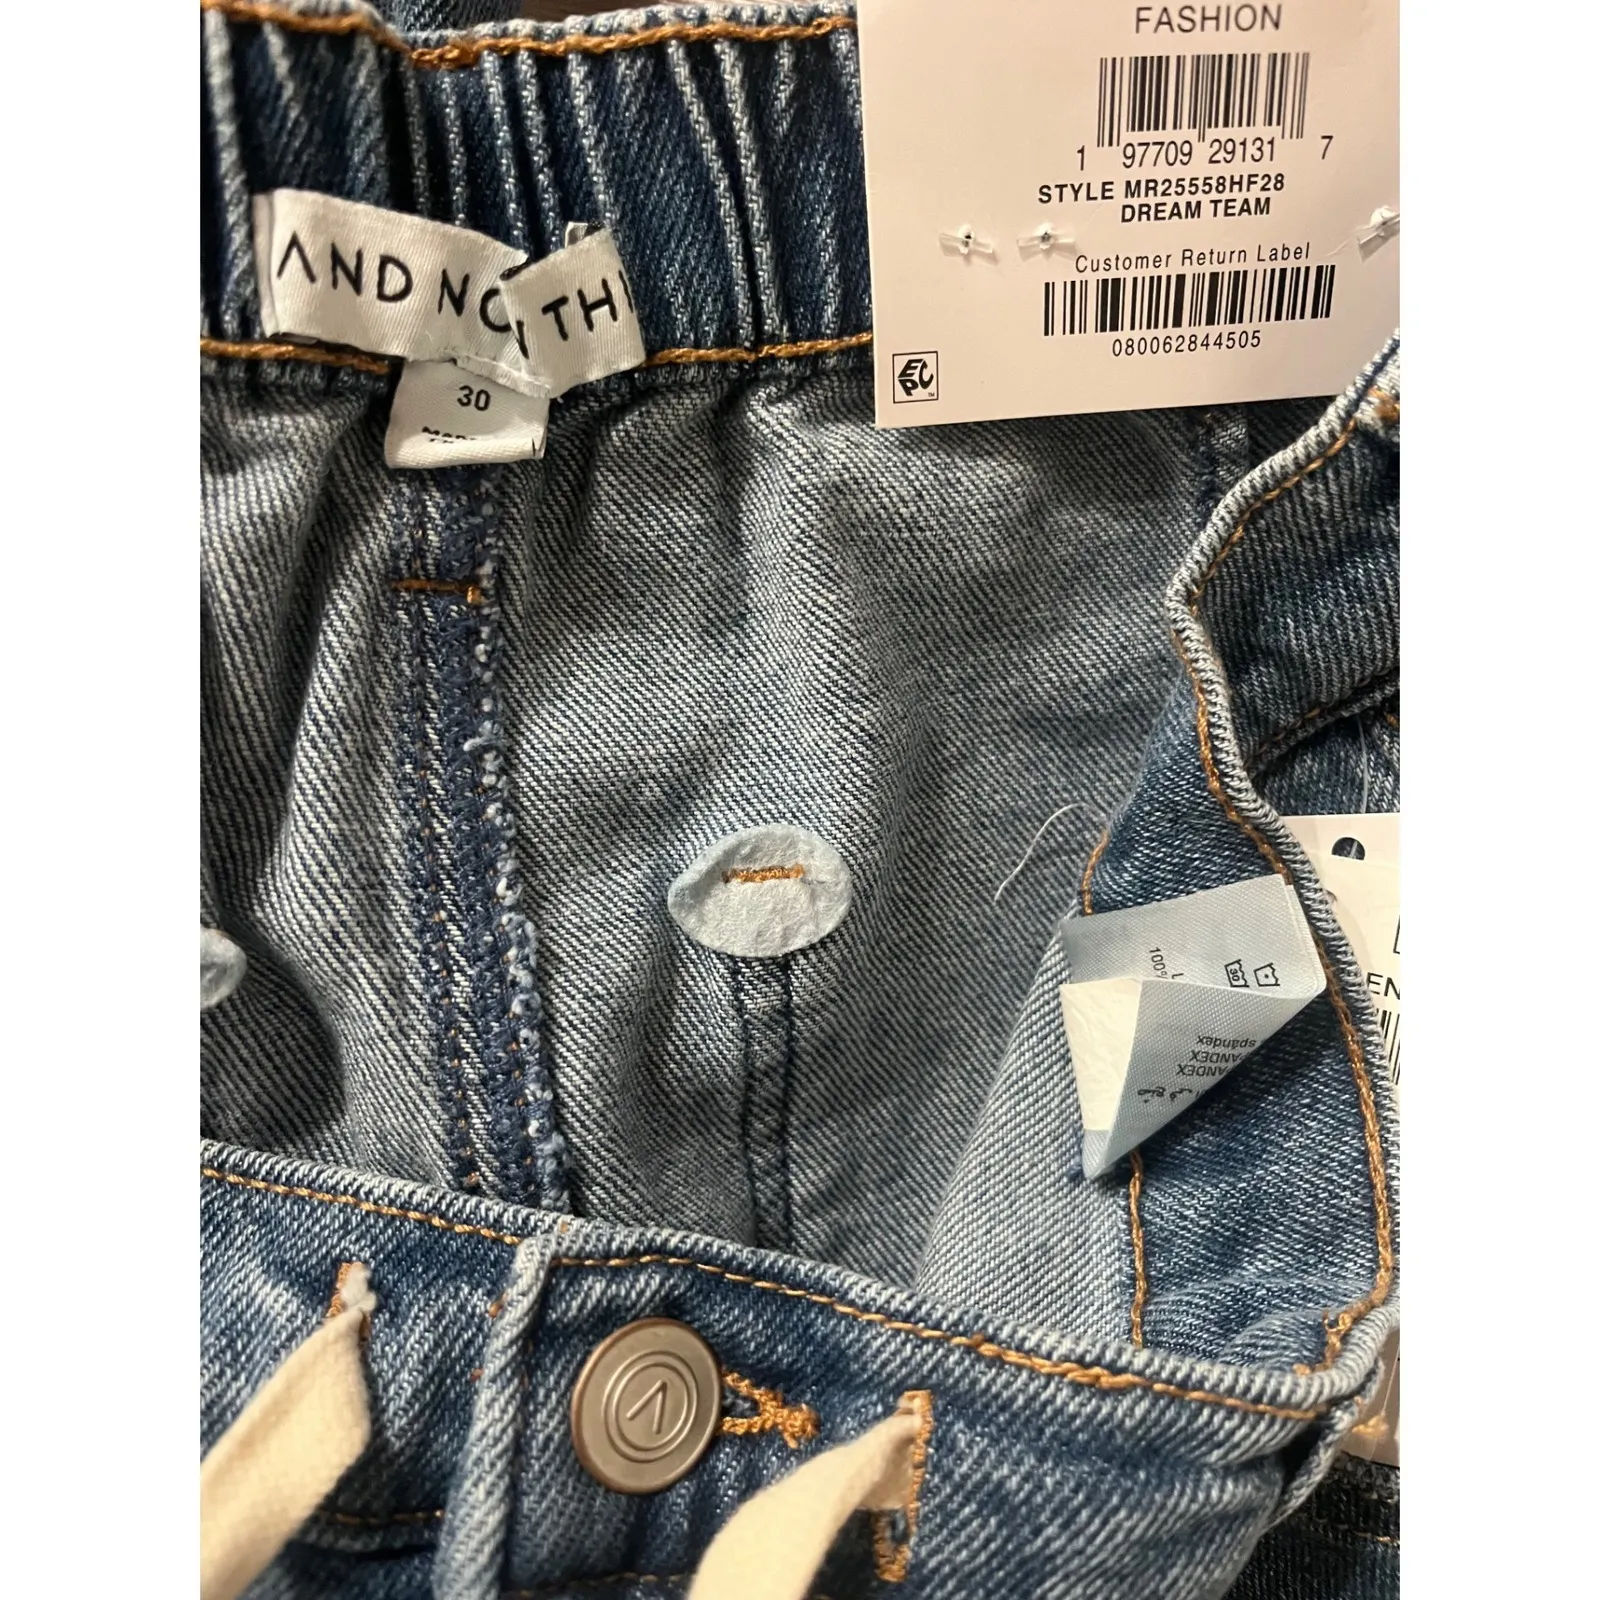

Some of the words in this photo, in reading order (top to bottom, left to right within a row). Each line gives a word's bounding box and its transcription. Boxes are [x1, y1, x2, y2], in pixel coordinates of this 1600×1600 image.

[1135, 4, 1282, 34] FASHION
[1076, 145, 1086, 171] 1
[1121, 139, 1193, 169] 97709
[1207, 137, 1275, 165] 29131
[1319, 135, 1335, 160] 7
[1038, 181, 1115, 205] STYLE
[1124, 173, 1285, 199] MR25558HF28
[1120, 201, 1202, 223] DREAM
[1209, 197, 1271, 219] TEAM
[1075, 252, 1173, 274] Customer
[1181, 247, 1247, 267] Return
[1256, 242, 1310, 263] Label
[1112, 329, 1261, 357] 080062844505
[457, 385, 491, 411] 30
[1176, 1063, 1229, 1077] ANDEX
[1188, 1049, 1249, 1063] ANDEX
